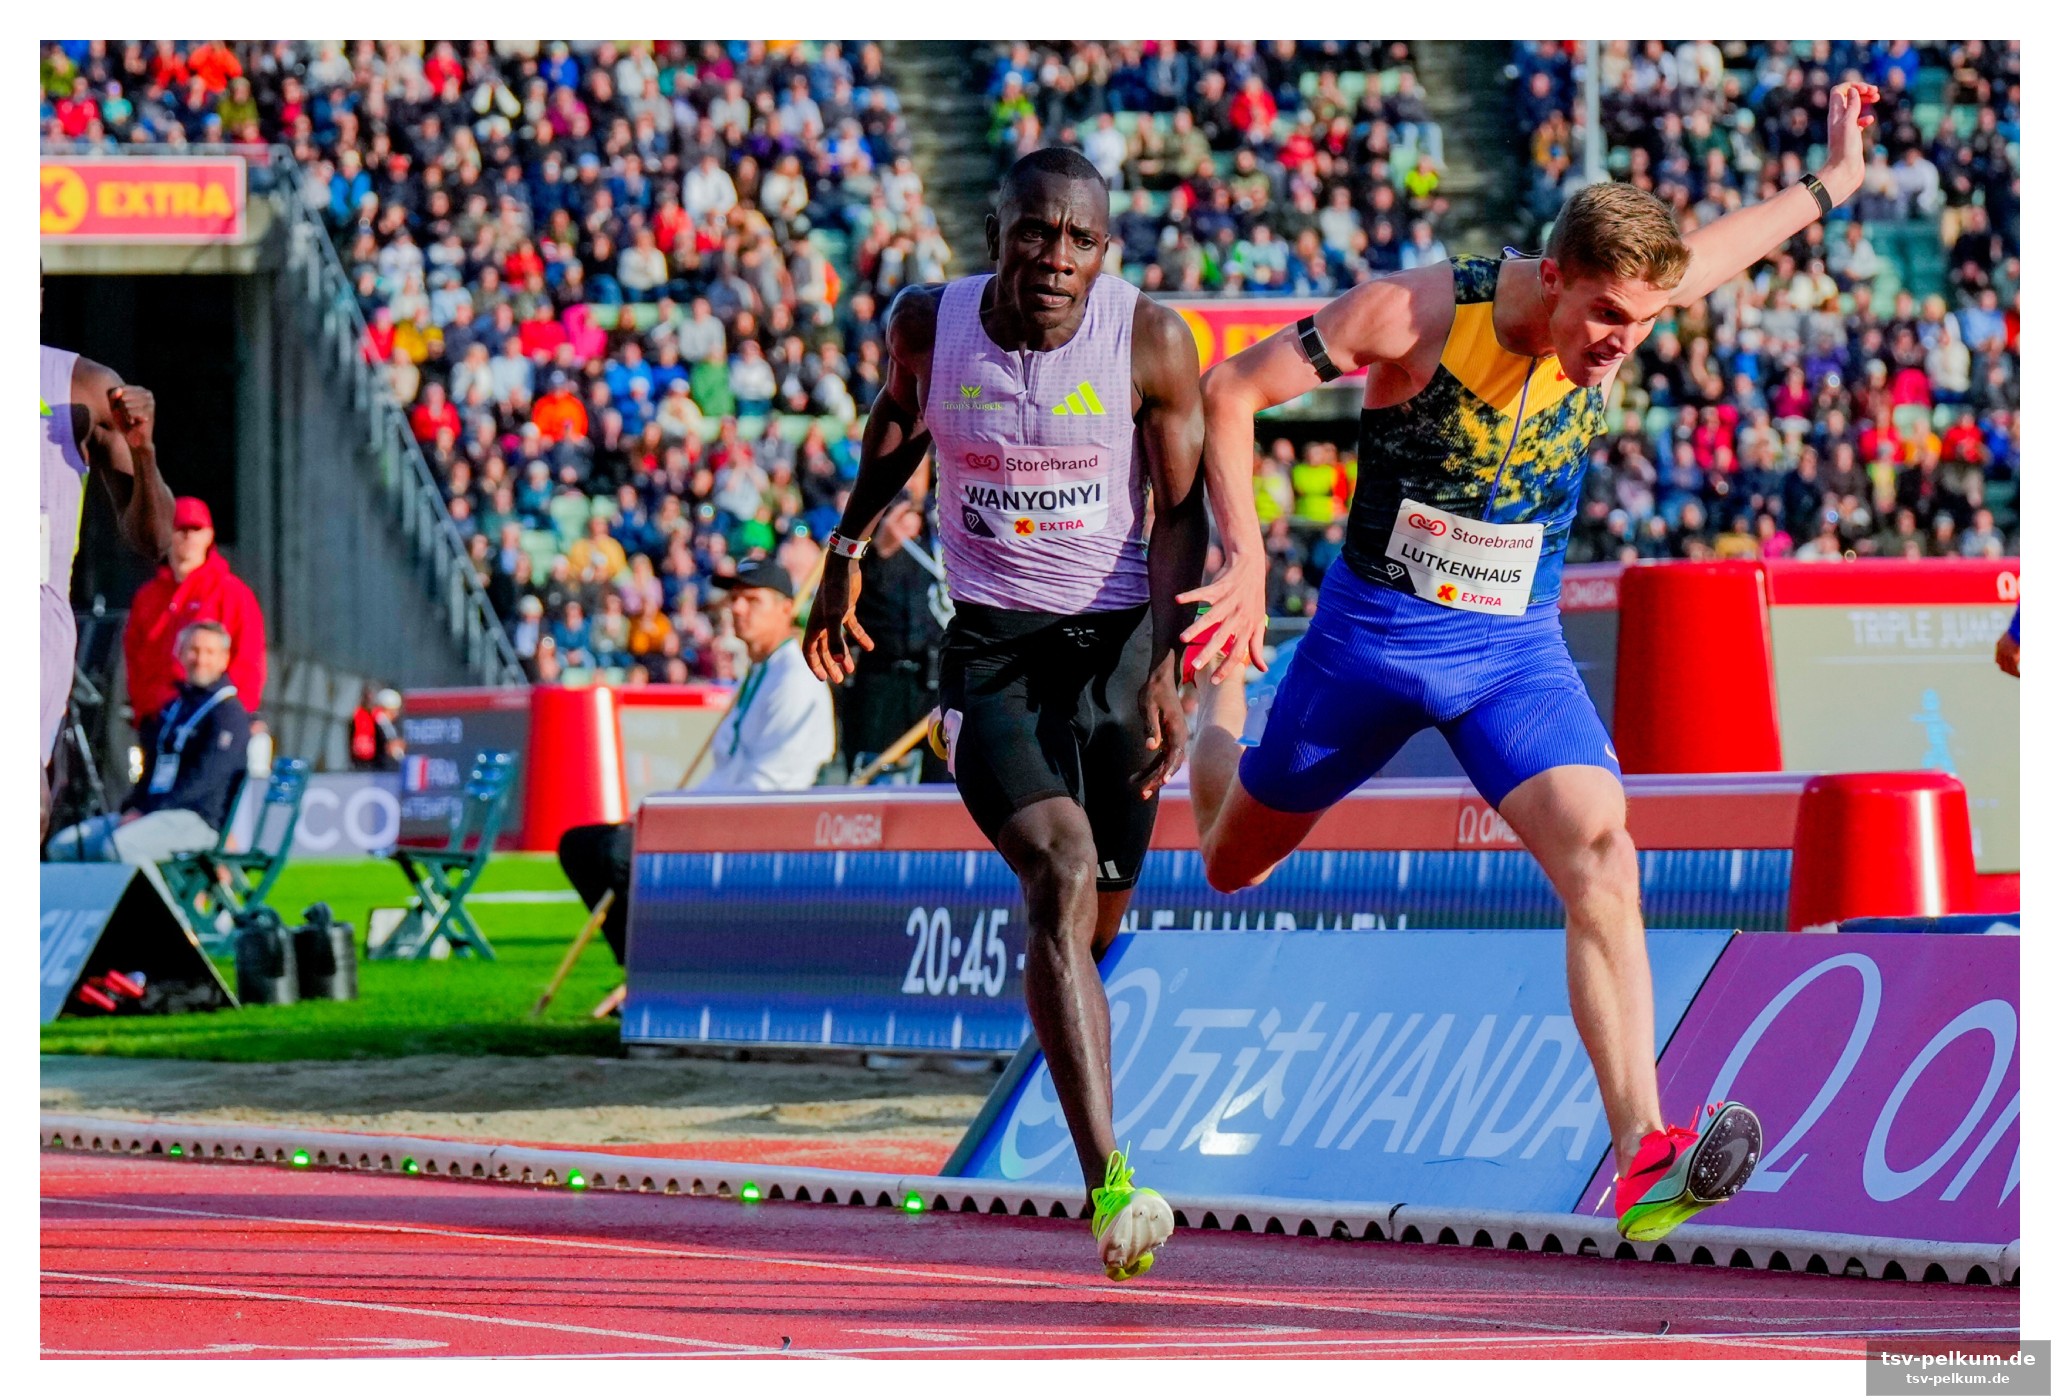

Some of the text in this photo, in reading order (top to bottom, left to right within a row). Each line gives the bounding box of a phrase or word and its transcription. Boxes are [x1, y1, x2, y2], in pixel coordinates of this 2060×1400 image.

[97, 182, 233, 218] EXTRA
[942, 401, 1001, 412] Tirop's Angels
[1005, 454, 1099, 472] Storebrand
[964, 482, 1101, 511] WANYONYI
[1039, 519, 1084, 532] EXTRA
[1451, 527, 1534, 549] Storebrand
[1401, 542, 1522, 583] LUTKENHAUS
[1461, 592, 1502, 606] EXTRA
[1848, 611, 1933, 648] TRIPLE
[902, 906, 1009, 997] 20:45
[1279, 1012, 1604, 1161] WANDA
